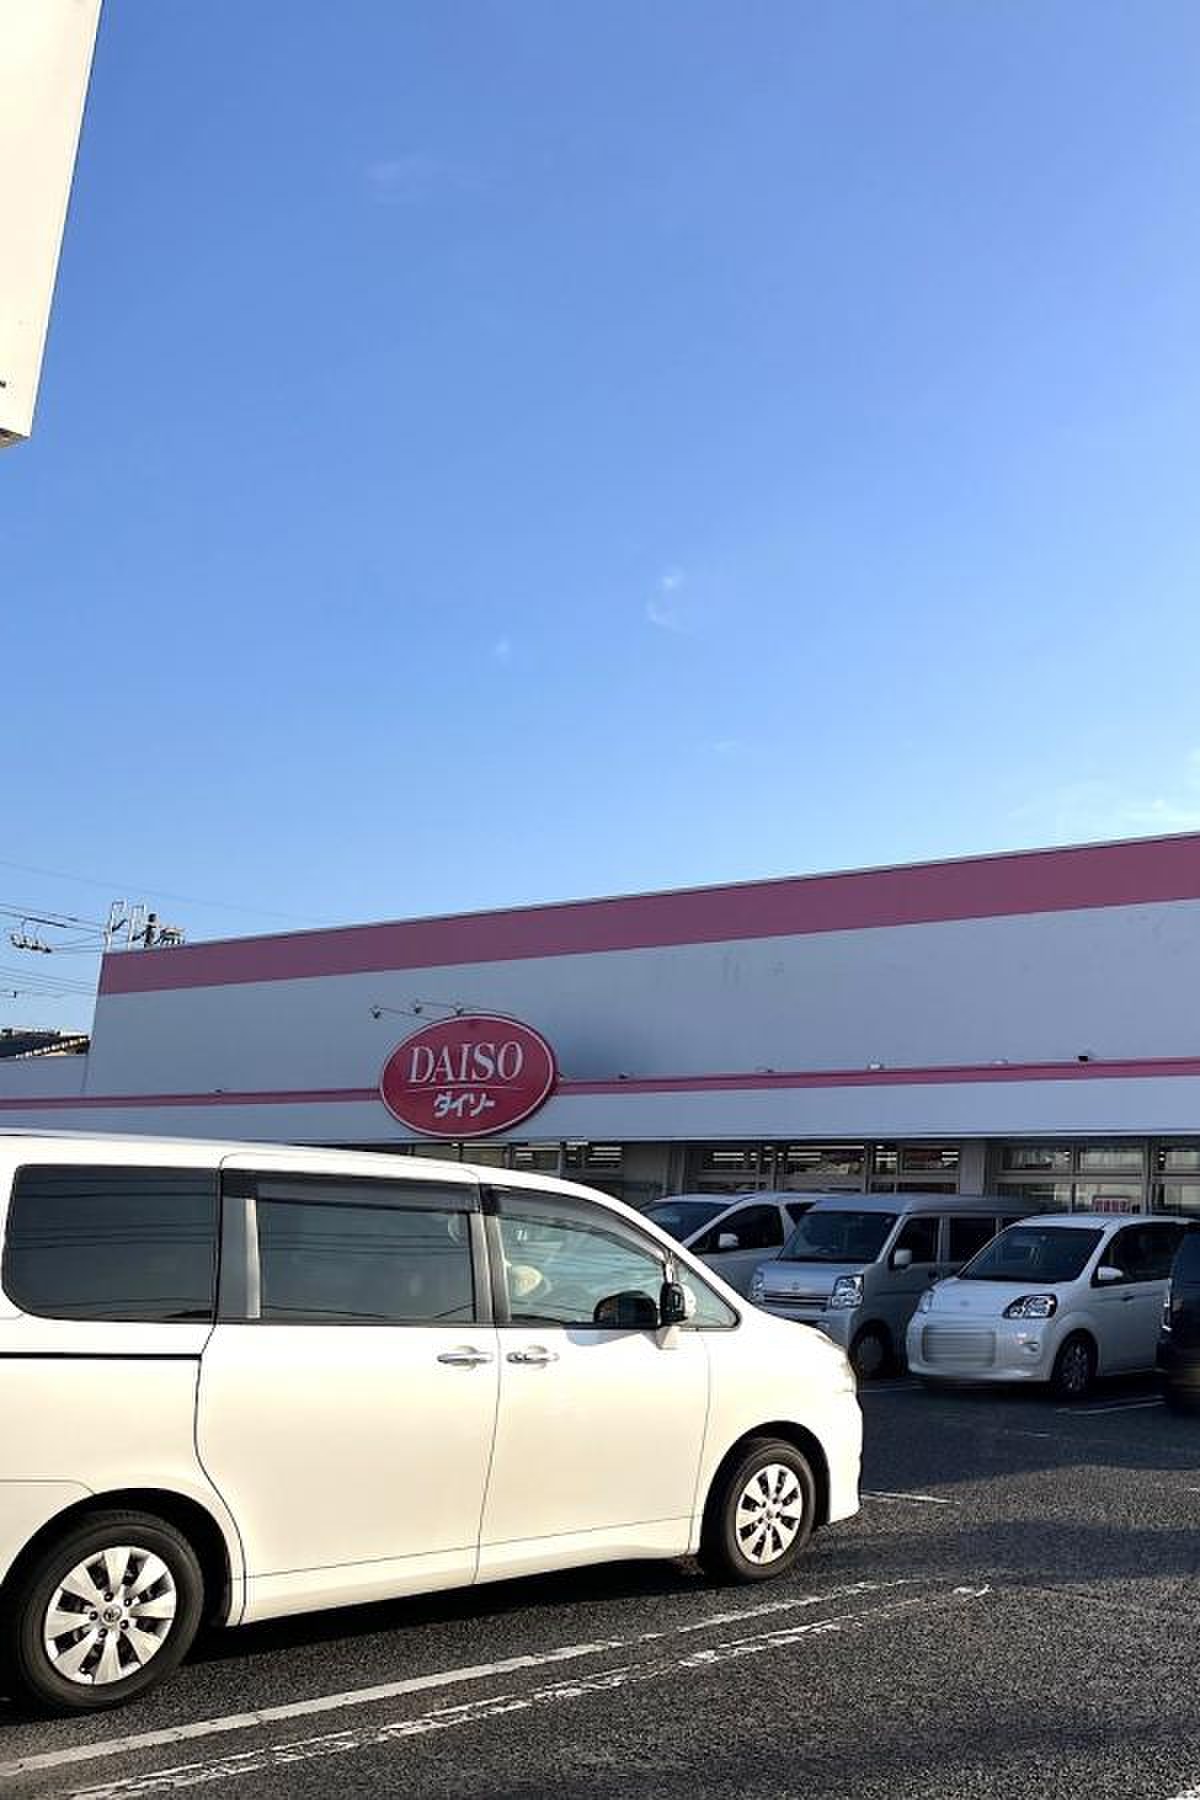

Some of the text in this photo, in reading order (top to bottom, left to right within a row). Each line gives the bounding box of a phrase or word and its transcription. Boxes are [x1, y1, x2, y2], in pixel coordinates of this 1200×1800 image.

[407, 1040, 524, 1084] DAISO
[433, 1090, 496, 1118] ダイソー
